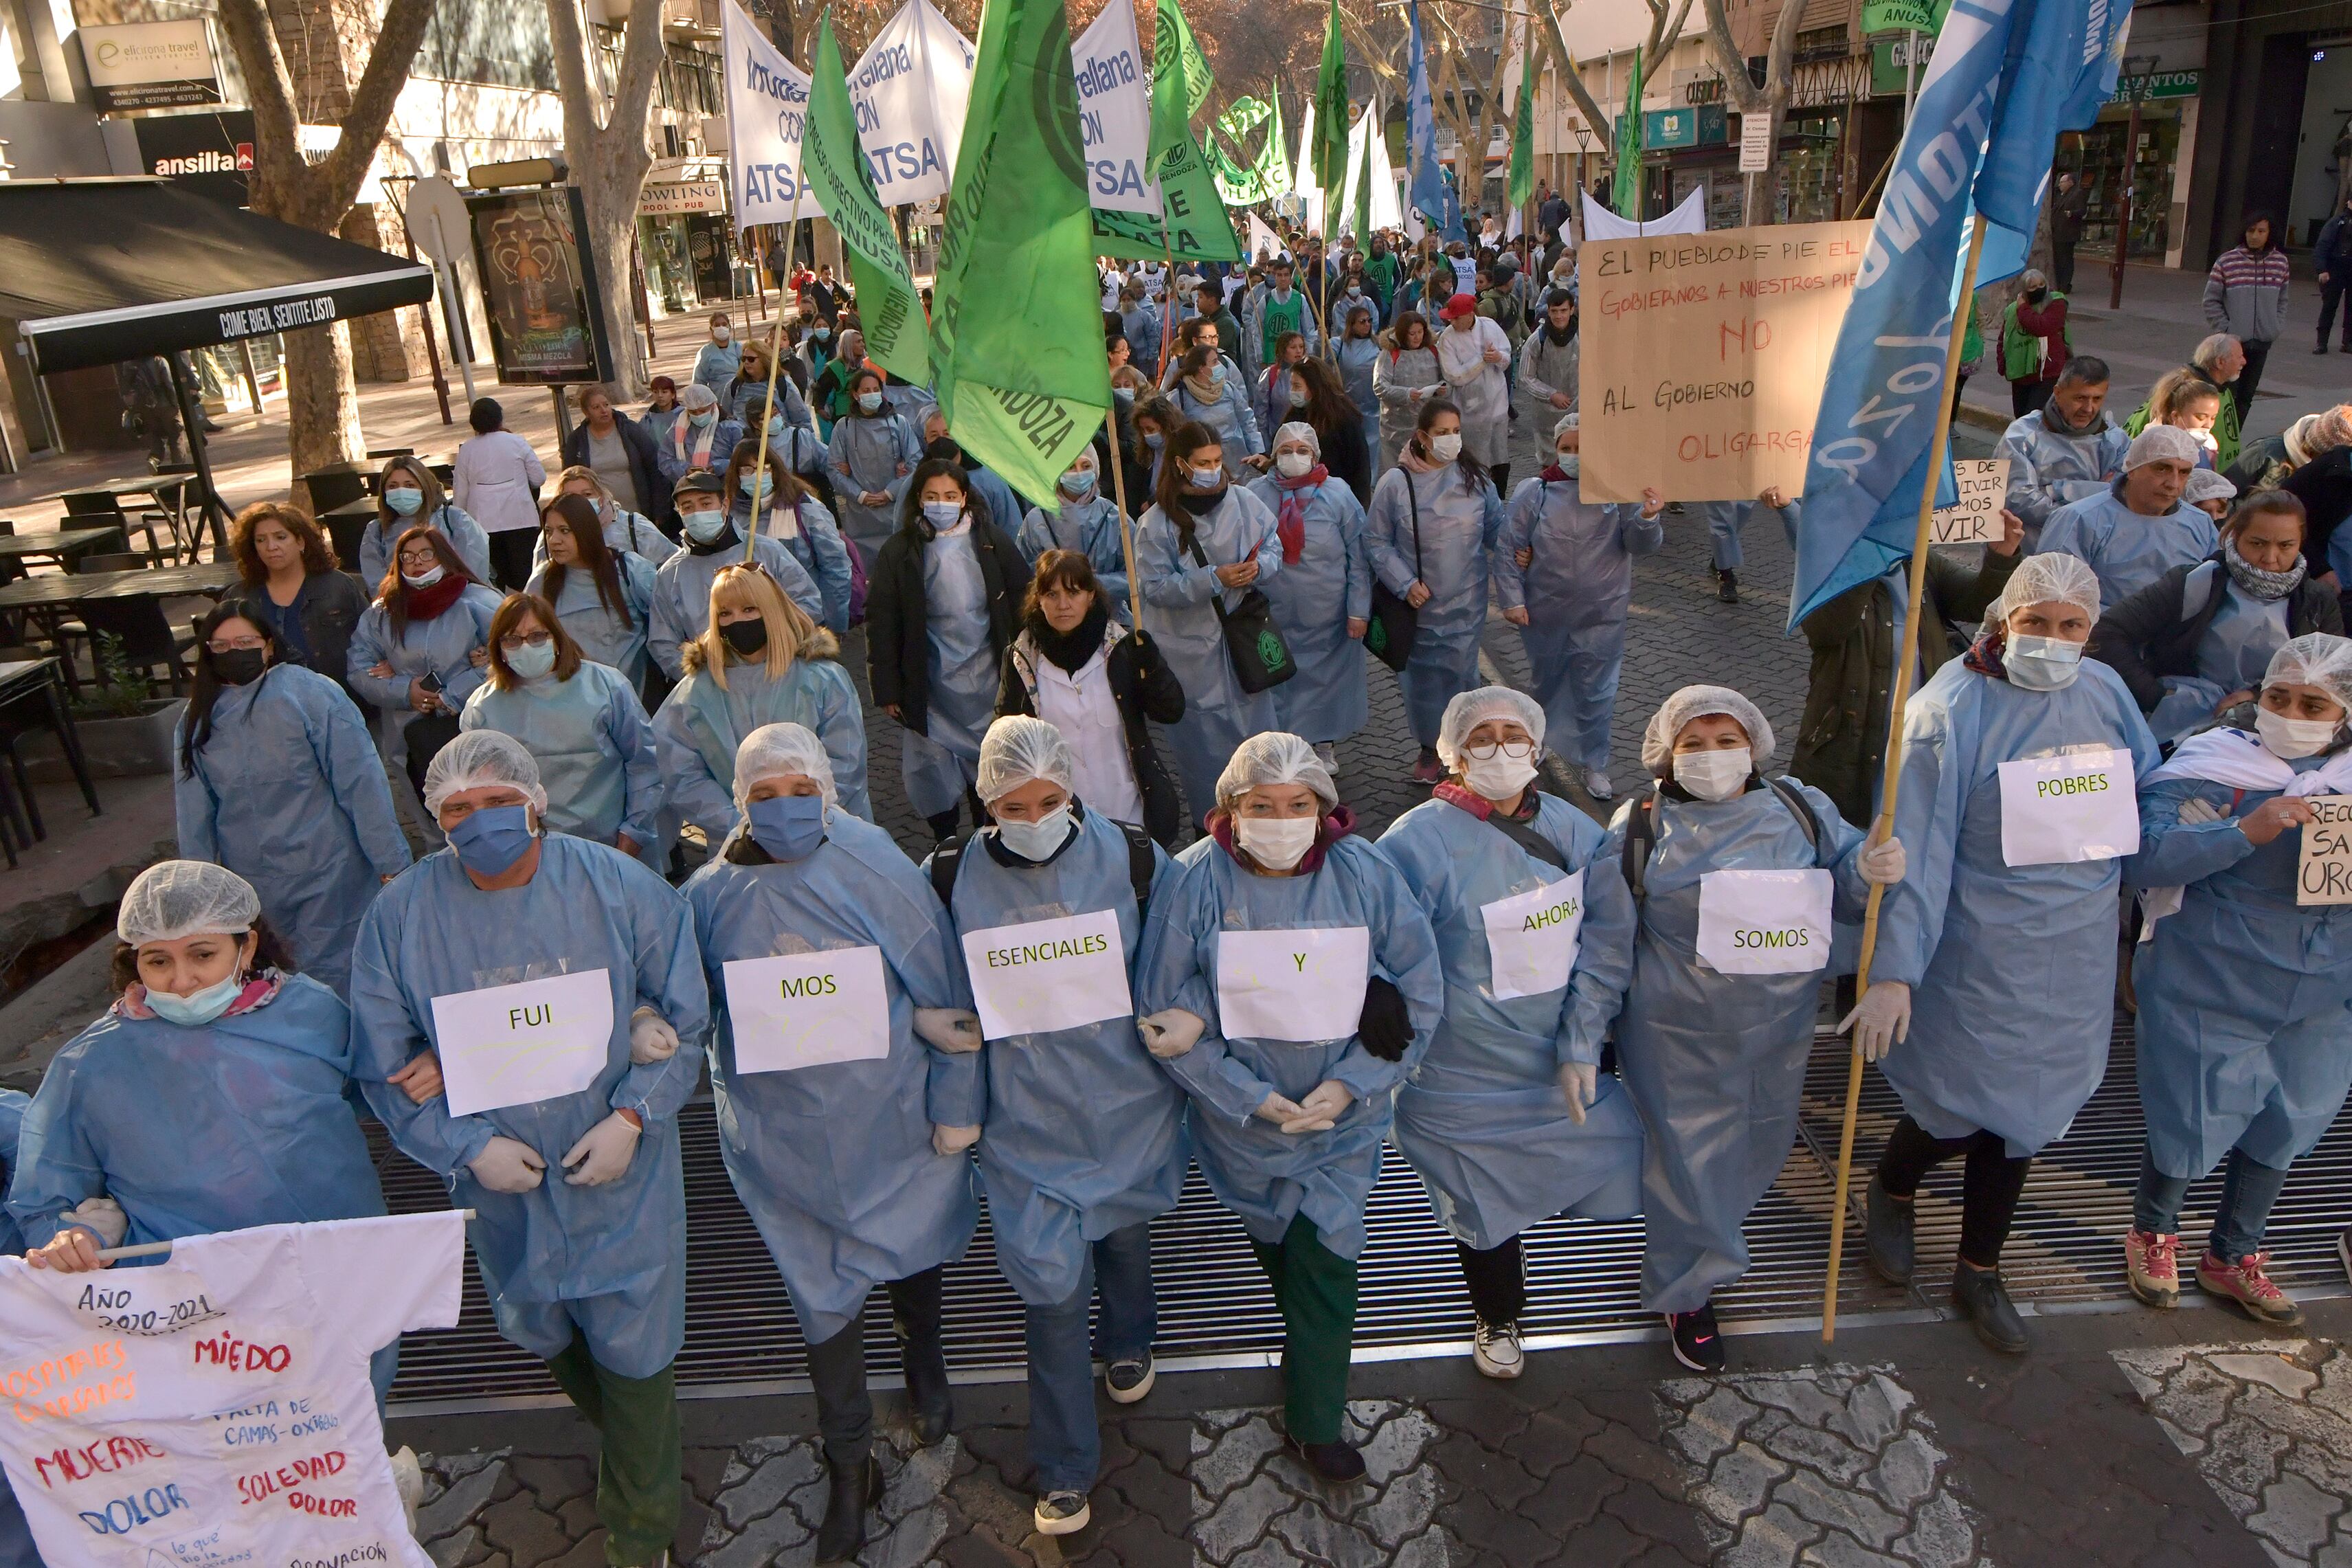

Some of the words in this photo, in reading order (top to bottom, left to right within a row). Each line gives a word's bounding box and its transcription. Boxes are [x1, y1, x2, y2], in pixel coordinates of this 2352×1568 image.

[124, 45, 166, 56] elicirona
[168, 41, 199, 53] travel
[145, 96, 172, 104] 4237495
[177, 93, 203, 102] 4631243
[155, 150, 234, 176] ansilta
[863, 137, 941, 186] ATSA
[1159, 164, 1198, 183] MENDOZA
[640, 186, 717, 203] OWLING
[643, 203, 670, 212] POOL
[684, 201, 705, 209] PUB
[828, 164, 871, 232] DIRECTIVO
[1598, 251, 1633, 276] EL
[1829, 240, 1860, 257] EL
[1600, 286, 1710, 321] GOBIERNOS
[1717, 282, 1732, 300] A
[1739, 276, 1825, 298] NUESTROS
[219, 310, 249, 338] COME
[248, 306, 276, 333] BIEN,
[273, 300, 313, 328] SENTITE
[309, 296, 336, 321] LISTO
[1719, 315, 1772, 363] NO
[519, 353, 542, 361] MISMA
[1603, 386, 1636, 416] AL
[1655, 380, 1755, 412] GOBIERNO
[1977, 461, 1997, 474] DE
[2037, 774, 2109, 798] POBRES
[1523, 897, 1579, 932] AHORA
[987, 933, 1108, 968] ESENCIALES
[1734, 928, 1809, 948] SOMOS
[1294, 953, 1306, 972] Y
[780, 974, 838, 1000] MOS
[508, 1003, 552, 1030] FUI
[78, 1284, 132, 1311] AÑO
[289, 1397, 311, 1415] DE
[34, 1437, 165, 1490] MUERTE
[237, 1450, 346, 1506] SOLEDAD
[78, 1483, 190, 1536] DOLOR
[289, 1490, 357, 1518] DOLOR
